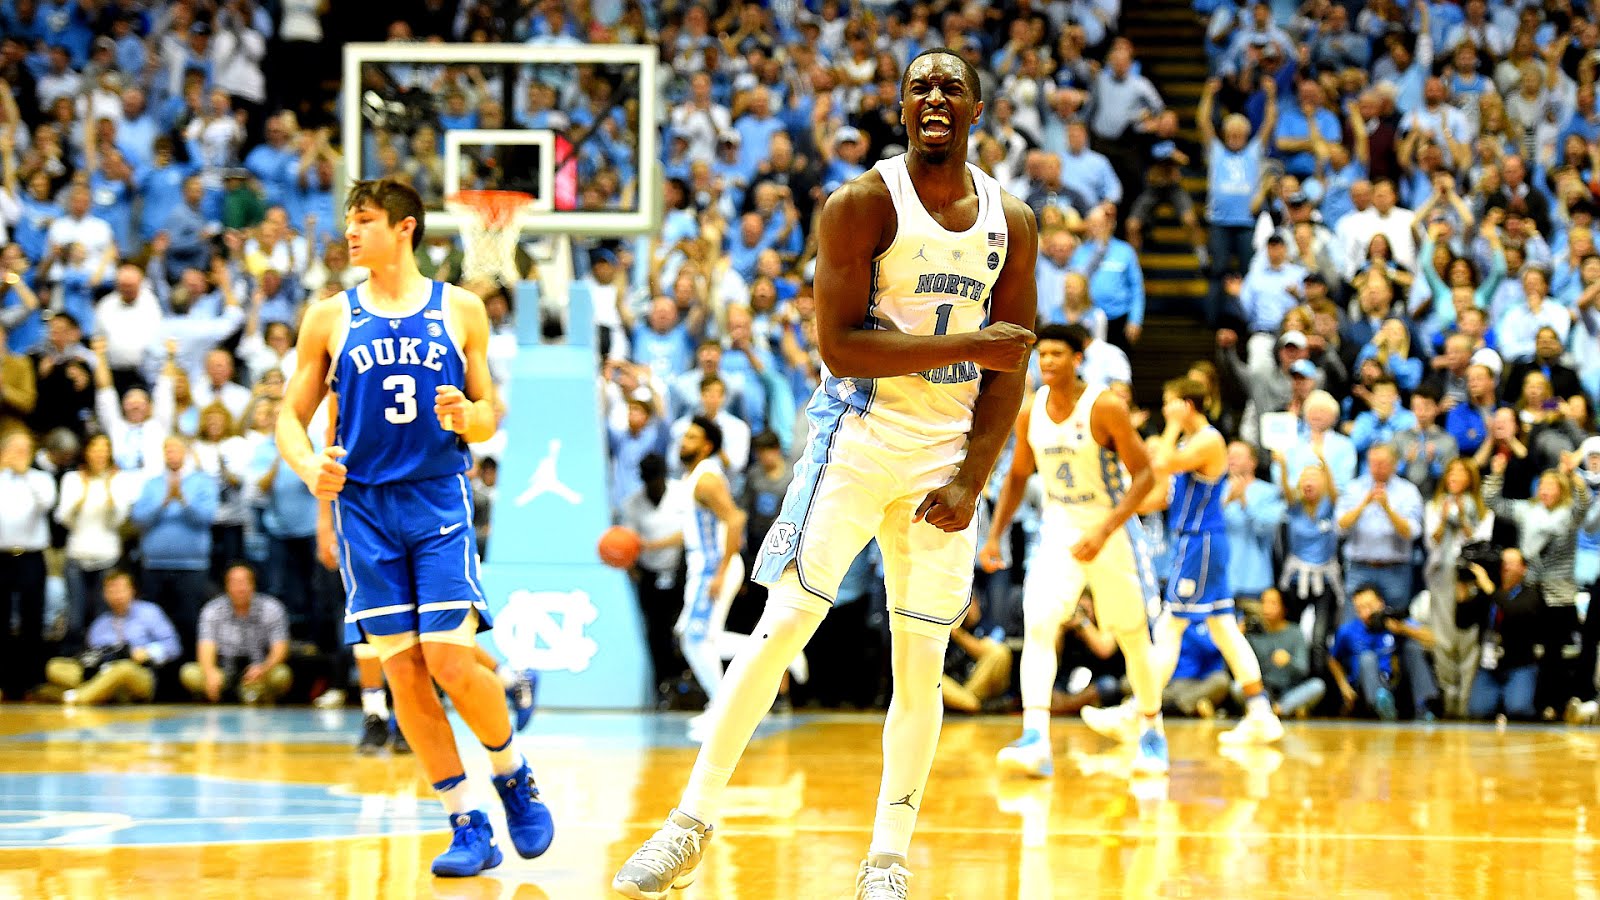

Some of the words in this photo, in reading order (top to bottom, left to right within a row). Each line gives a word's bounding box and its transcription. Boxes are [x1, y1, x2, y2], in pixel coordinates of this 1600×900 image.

[915, 273, 986, 302] NORTH
[933, 303, 954, 336] 1
[349, 337, 448, 375] DUKE
[383, 374, 418, 424] 3
[1056, 462, 1075, 488] 4
